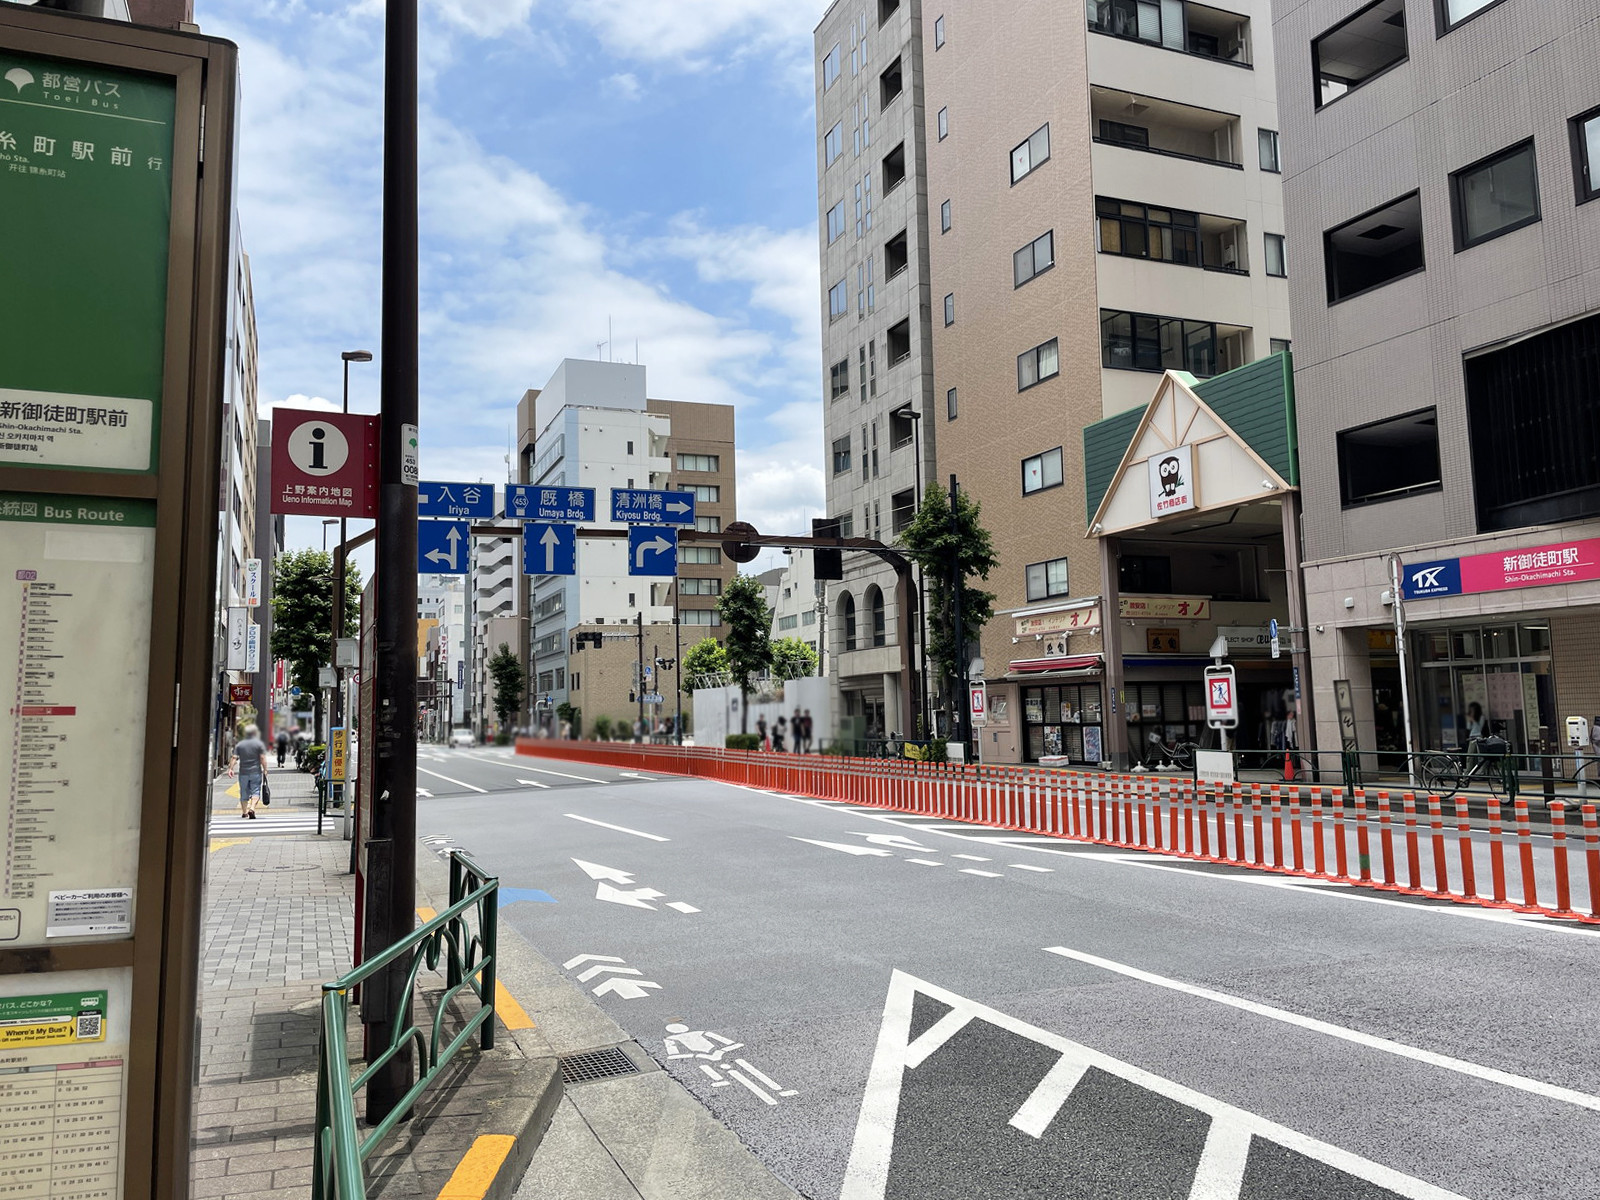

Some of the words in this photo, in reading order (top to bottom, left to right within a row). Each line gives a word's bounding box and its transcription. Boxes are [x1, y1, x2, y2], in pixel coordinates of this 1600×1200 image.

[42, 72, 121, 98] 都営バス
[43, 91, 80, 104] Toei
[91, 98, 119, 110] Bus
[147, 156, 163, 171] 行
[0, 401, 128, 428] 新御徒町駅前
[68, 427, 83, 435] Sta.
[282, 484, 353, 497] 上野案内地図
[437, 486, 481, 504] 入谷
[540, 489, 585, 508] 厩橋
[282, 495, 300, 504] Ueno
[301, 496, 338, 506] Information
[338, 497, 353, 507] Map
[514, 498, 528, 506] 453
[615, 492, 663, 510] 清洲橋
[0, 501, 38, 517] 統図
[43, 506, 73, 518] Bus
[77, 508, 125, 521] Route
[448, 505, 470, 516] Iriya
[538, 508, 565, 519] Umaya
[566, 509, 586, 520] Brdg.
[615, 510, 641, 521] Kiyosu
[643, 511, 663, 523] Brdg.
[1502, 547, 1580, 572] 新御徒町駅
[1411, 566, 1446, 588] TX
[1504, 571, 1561, 583] Shin-Okachimachi
[1562, 569, 1577, 577] Sta.
[1177, 601, 1205, 616] オノ
[1070, 610, 1093, 627] オノ
[333, 730, 343, 776] 歩行者優先
[6, 1028, 35, 1036] Where's
[36, 1027, 47, 1035] My
[48, 1026, 68, 1034] Bus?
